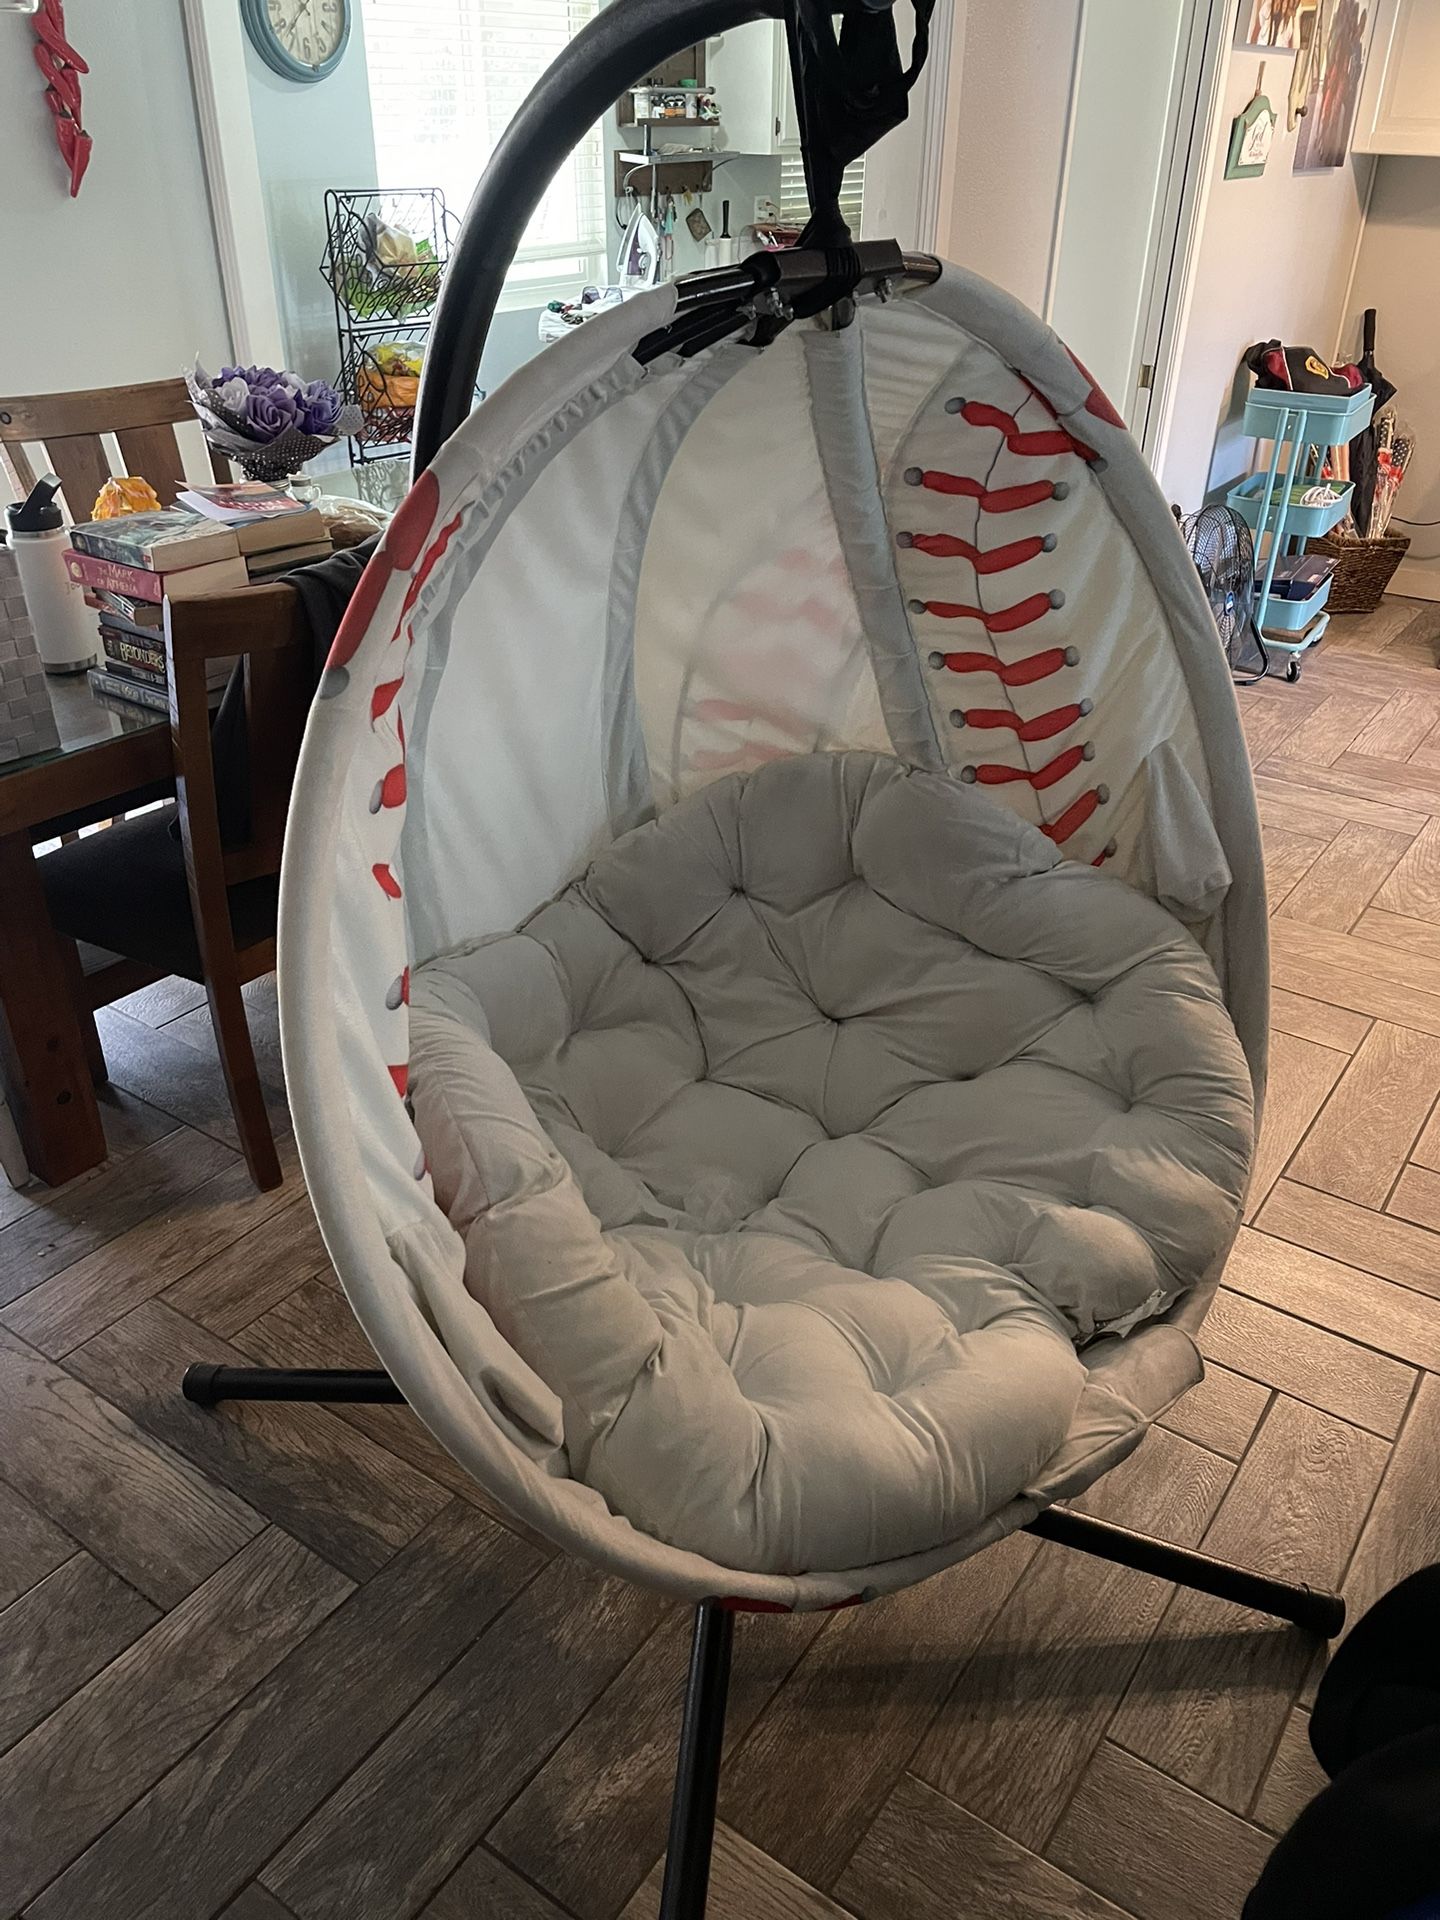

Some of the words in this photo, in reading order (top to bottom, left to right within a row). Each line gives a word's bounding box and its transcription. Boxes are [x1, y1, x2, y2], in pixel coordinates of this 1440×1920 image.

[322, 2, 337, 13] 3
[302, 36, 311, 59] 6
[107, 564, 135, 582] MARK
[106, 577, 138, 595] ATHENA
